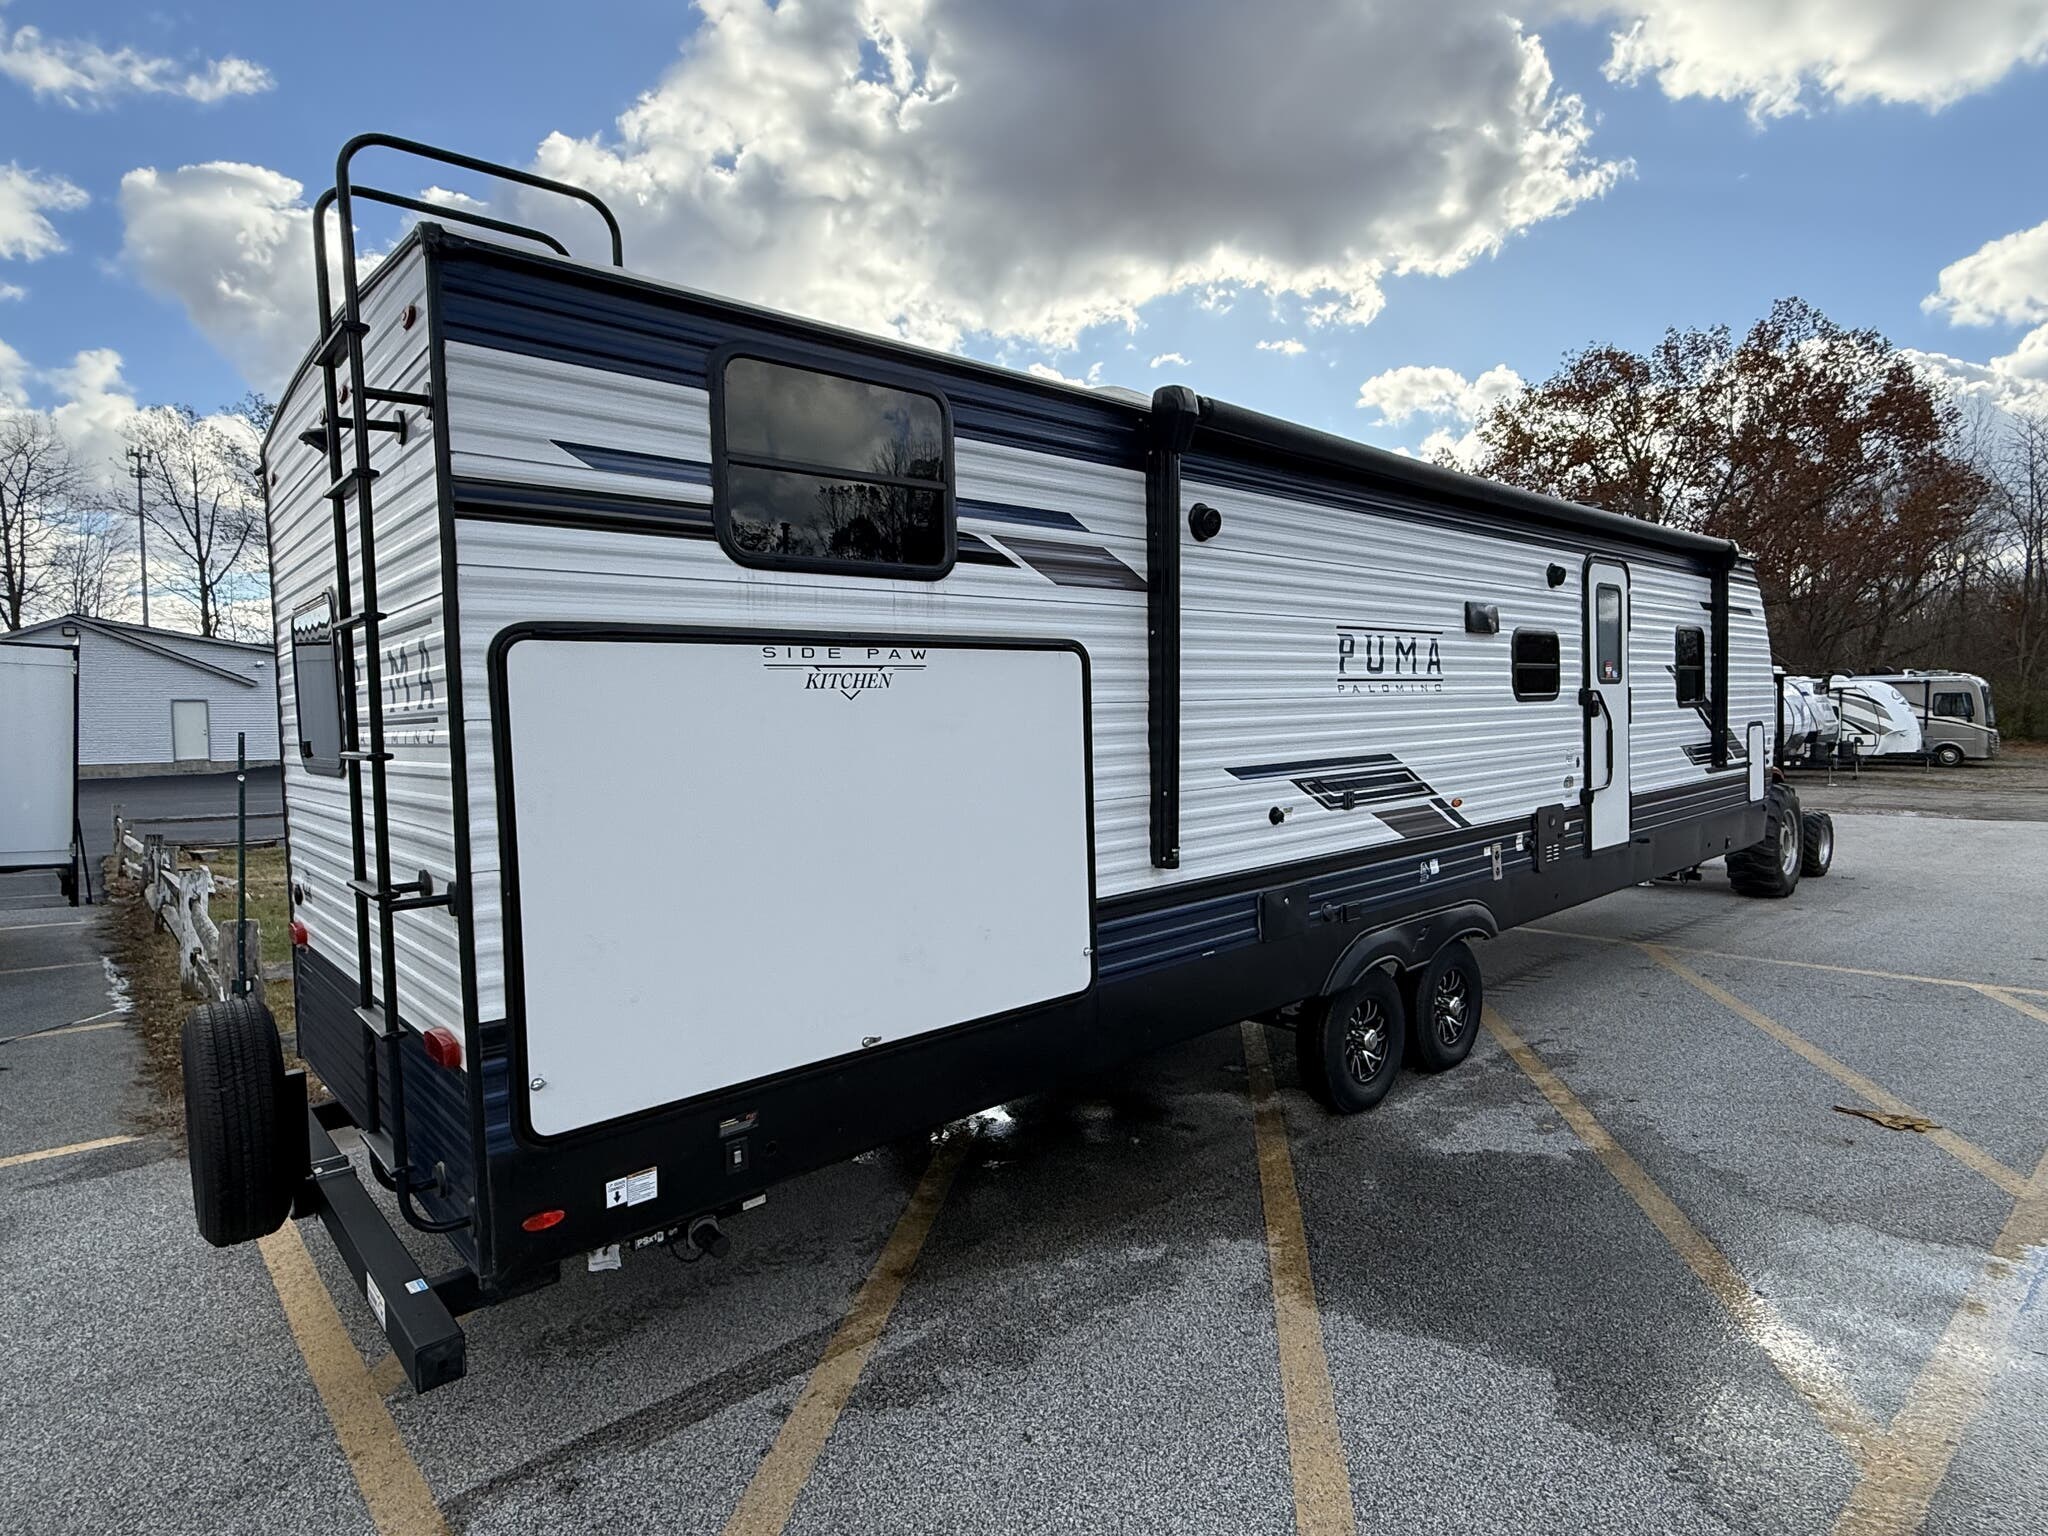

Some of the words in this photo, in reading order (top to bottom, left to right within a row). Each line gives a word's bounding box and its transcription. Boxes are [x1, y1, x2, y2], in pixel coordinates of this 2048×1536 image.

[762, 646, 842, 659] SIDE
[867, 648, 928, 660] PAW
[1337, 633, 1443, 675] PUMA
[803, 672, 894, 690] KITCHEN
[1337, 683, 1443, 694] PALOMINO
